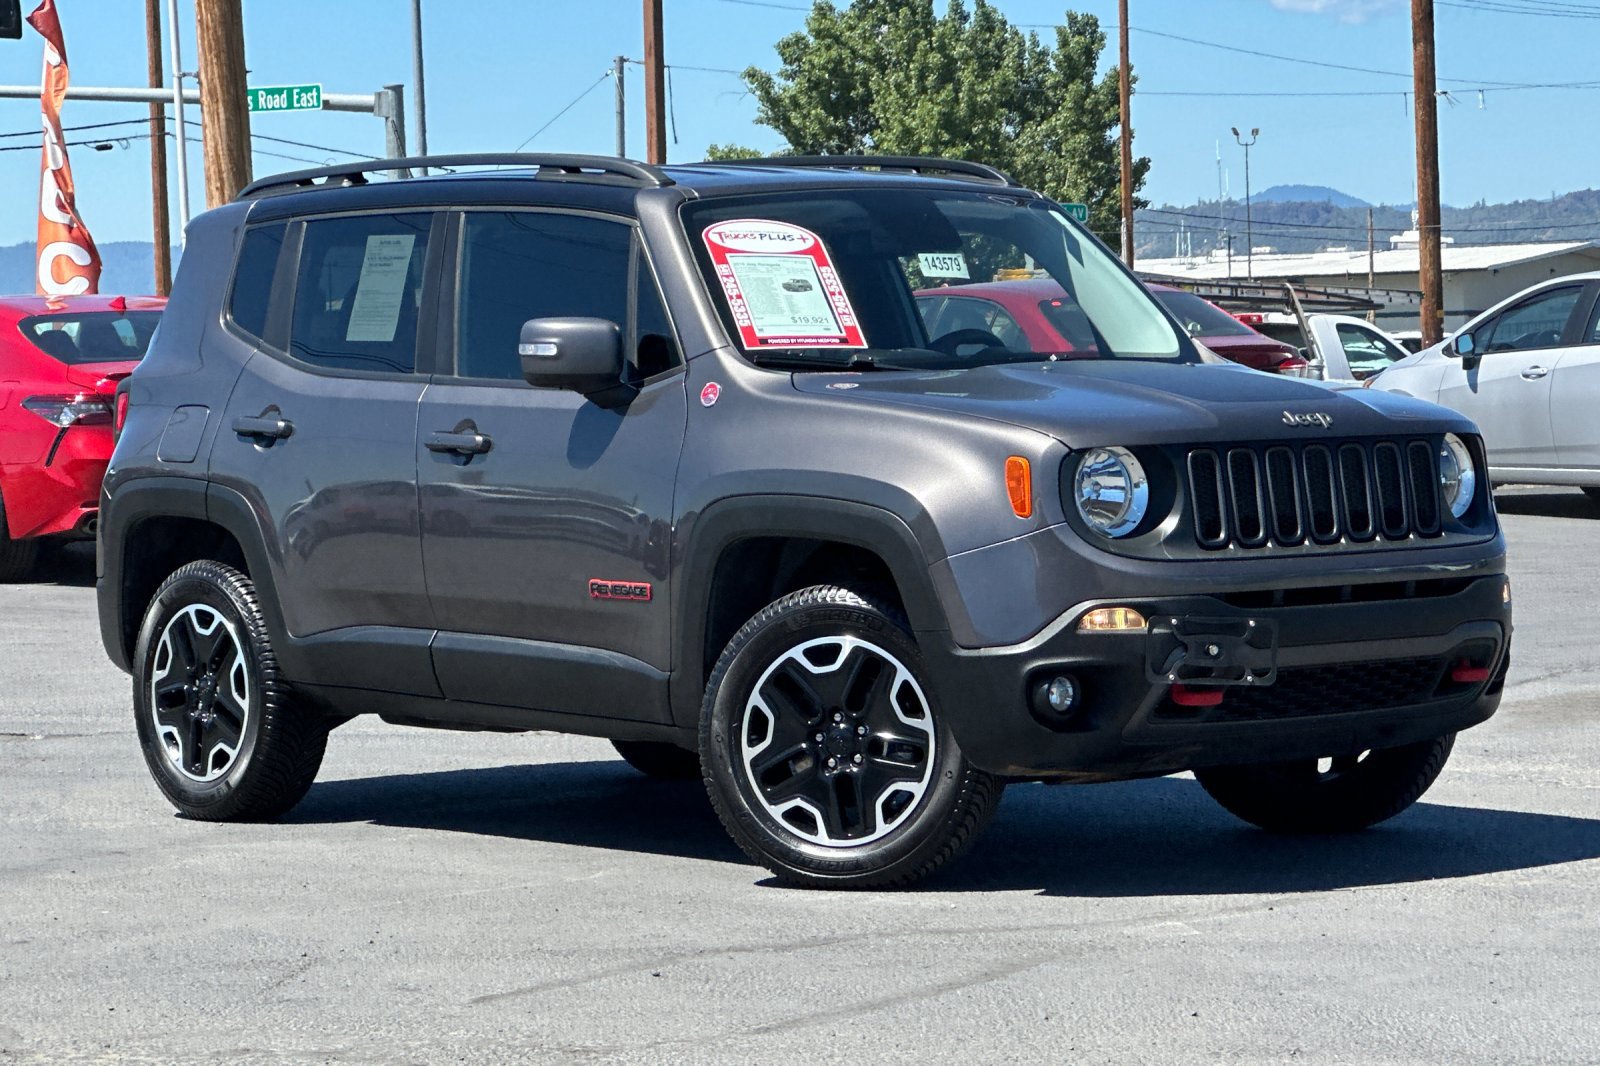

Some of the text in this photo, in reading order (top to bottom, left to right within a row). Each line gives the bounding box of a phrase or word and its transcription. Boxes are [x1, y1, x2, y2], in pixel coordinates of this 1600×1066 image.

[258, 90, 287, 109] Road
[293, 88, 318, 107] East
[759, 233, 795, 242] PLUS
[924, 256, 962, 272] 143579
[790, 315, 830, 325] $19,921
[1282, 410, 1333, 429] Jeep
[589, 579, 651, 601] RENEGADE
